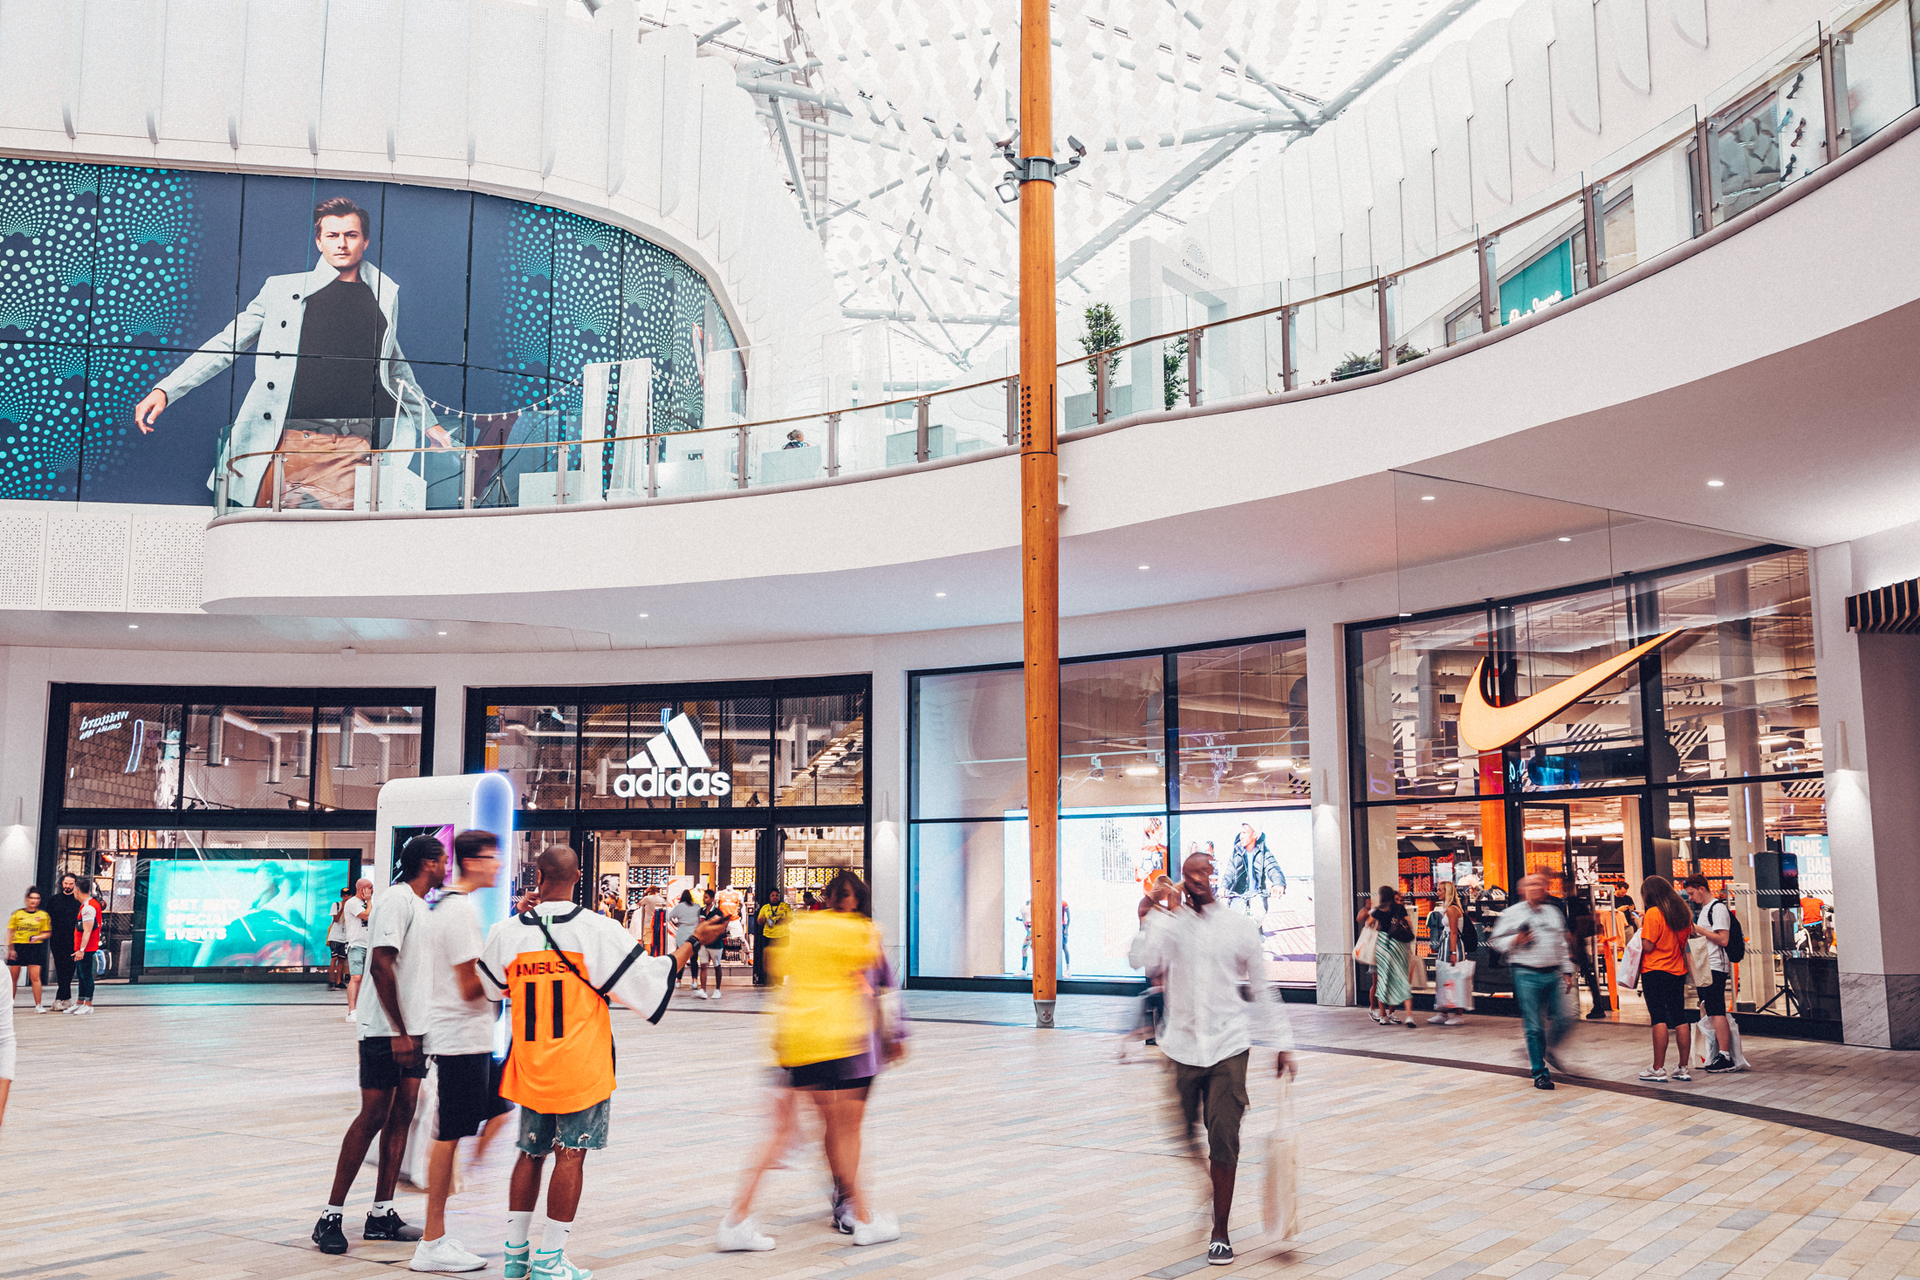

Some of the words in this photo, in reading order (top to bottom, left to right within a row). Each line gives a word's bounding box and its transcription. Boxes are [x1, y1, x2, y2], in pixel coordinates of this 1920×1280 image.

[613, 765, 731, 798] adidas
[1790, 839, 1823, 857] COME
[1806, 856, 1831, 874] BAC
[167, 899, 200, 911] GET
[166, 913, 232, 926] SPECIAL
[165, 927, 227, 940] EVENTS
[516, 960, 579, 977] AMBUS
[525, 980, 564, 1042] 11
